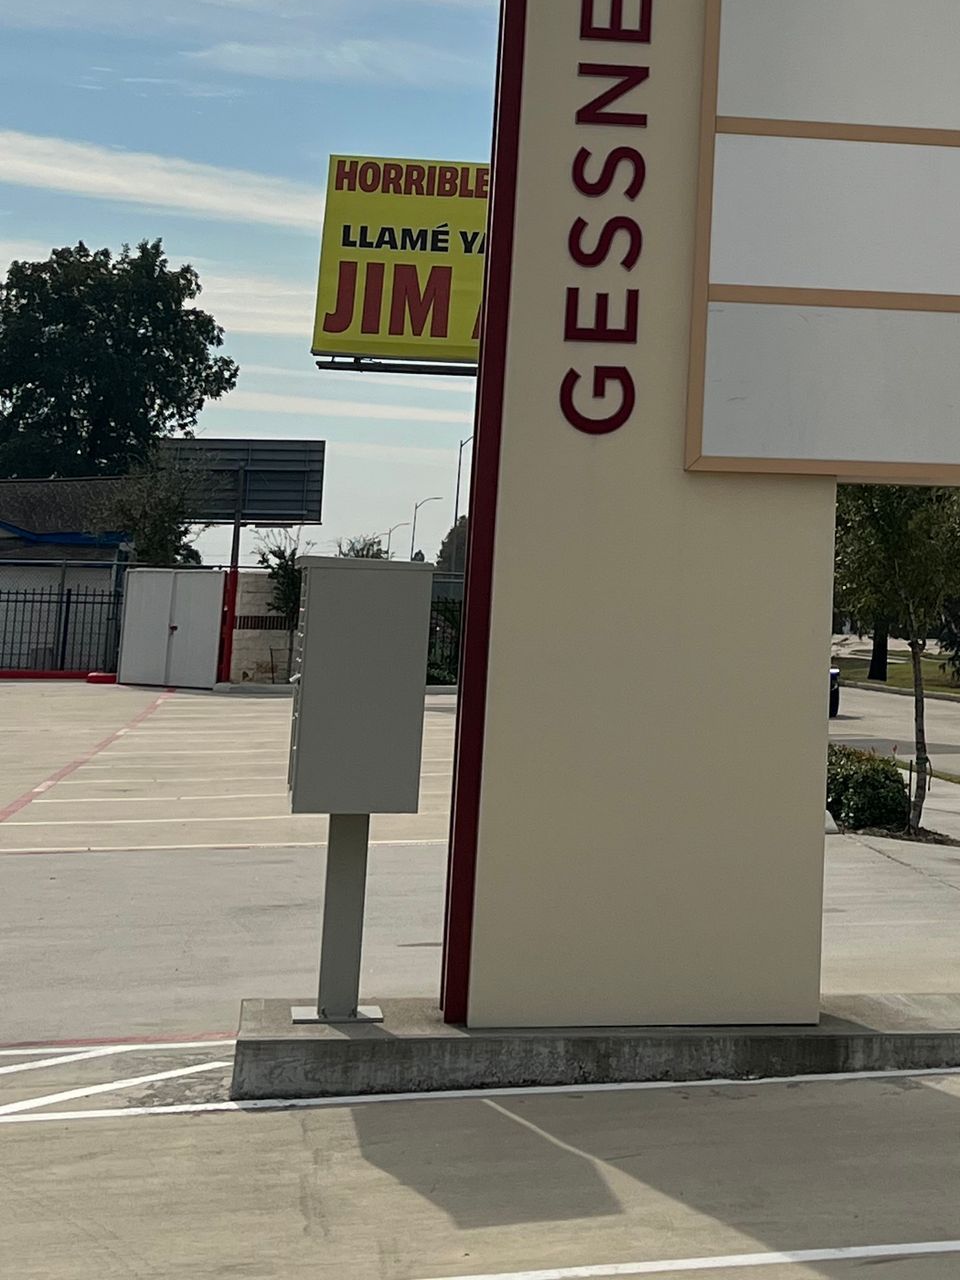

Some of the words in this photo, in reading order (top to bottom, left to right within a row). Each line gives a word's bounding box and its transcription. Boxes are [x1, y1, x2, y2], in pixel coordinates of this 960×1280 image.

[335, 160, 489, 199] HORRIBLE
[341, 223, 450, 253] LLAMÉ
[459, 230, 486, 255] Y
[322, 261, 452, 338] JIM
